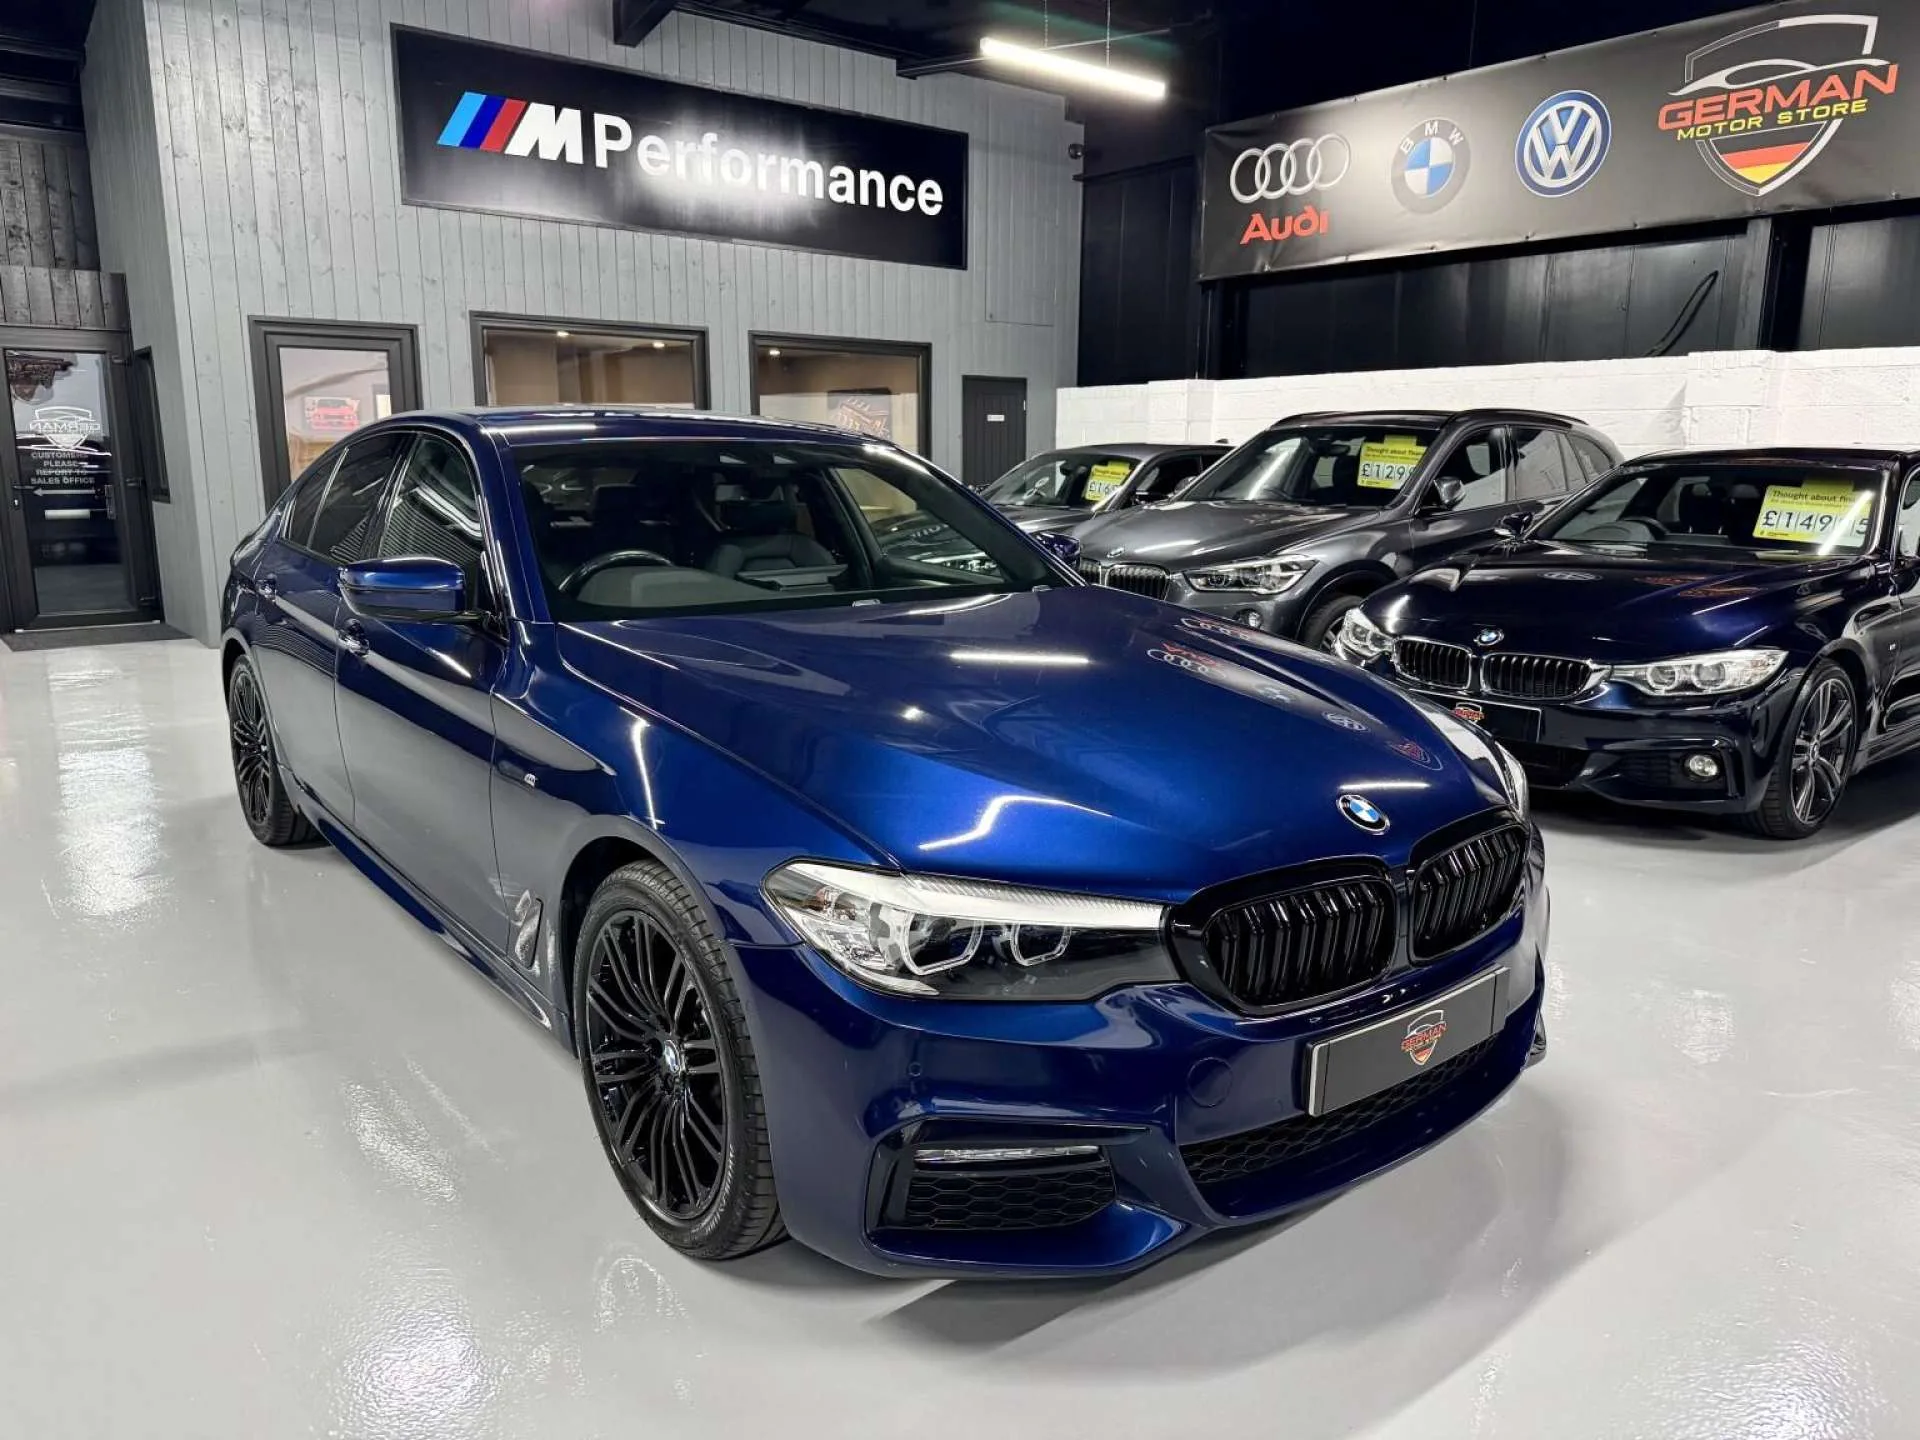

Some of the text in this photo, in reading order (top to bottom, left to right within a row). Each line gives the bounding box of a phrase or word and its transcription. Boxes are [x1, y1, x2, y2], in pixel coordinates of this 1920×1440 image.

[1657, 64, 1899, 131] GERMAN
[1400, 120, 1464, 154] BMW
[1676, 99, 1868, 141] MOTOR STORE
[593, 113, 943, 216] Performance
[1240, 205, 1329, 245] Audi
[30, 476, 95, 485] SALES OFFICE
[1773, 490, 1809, 501] Thought
[1810, 494, 1837, 502] about
[1762, 510, 1868, 534] £1495
